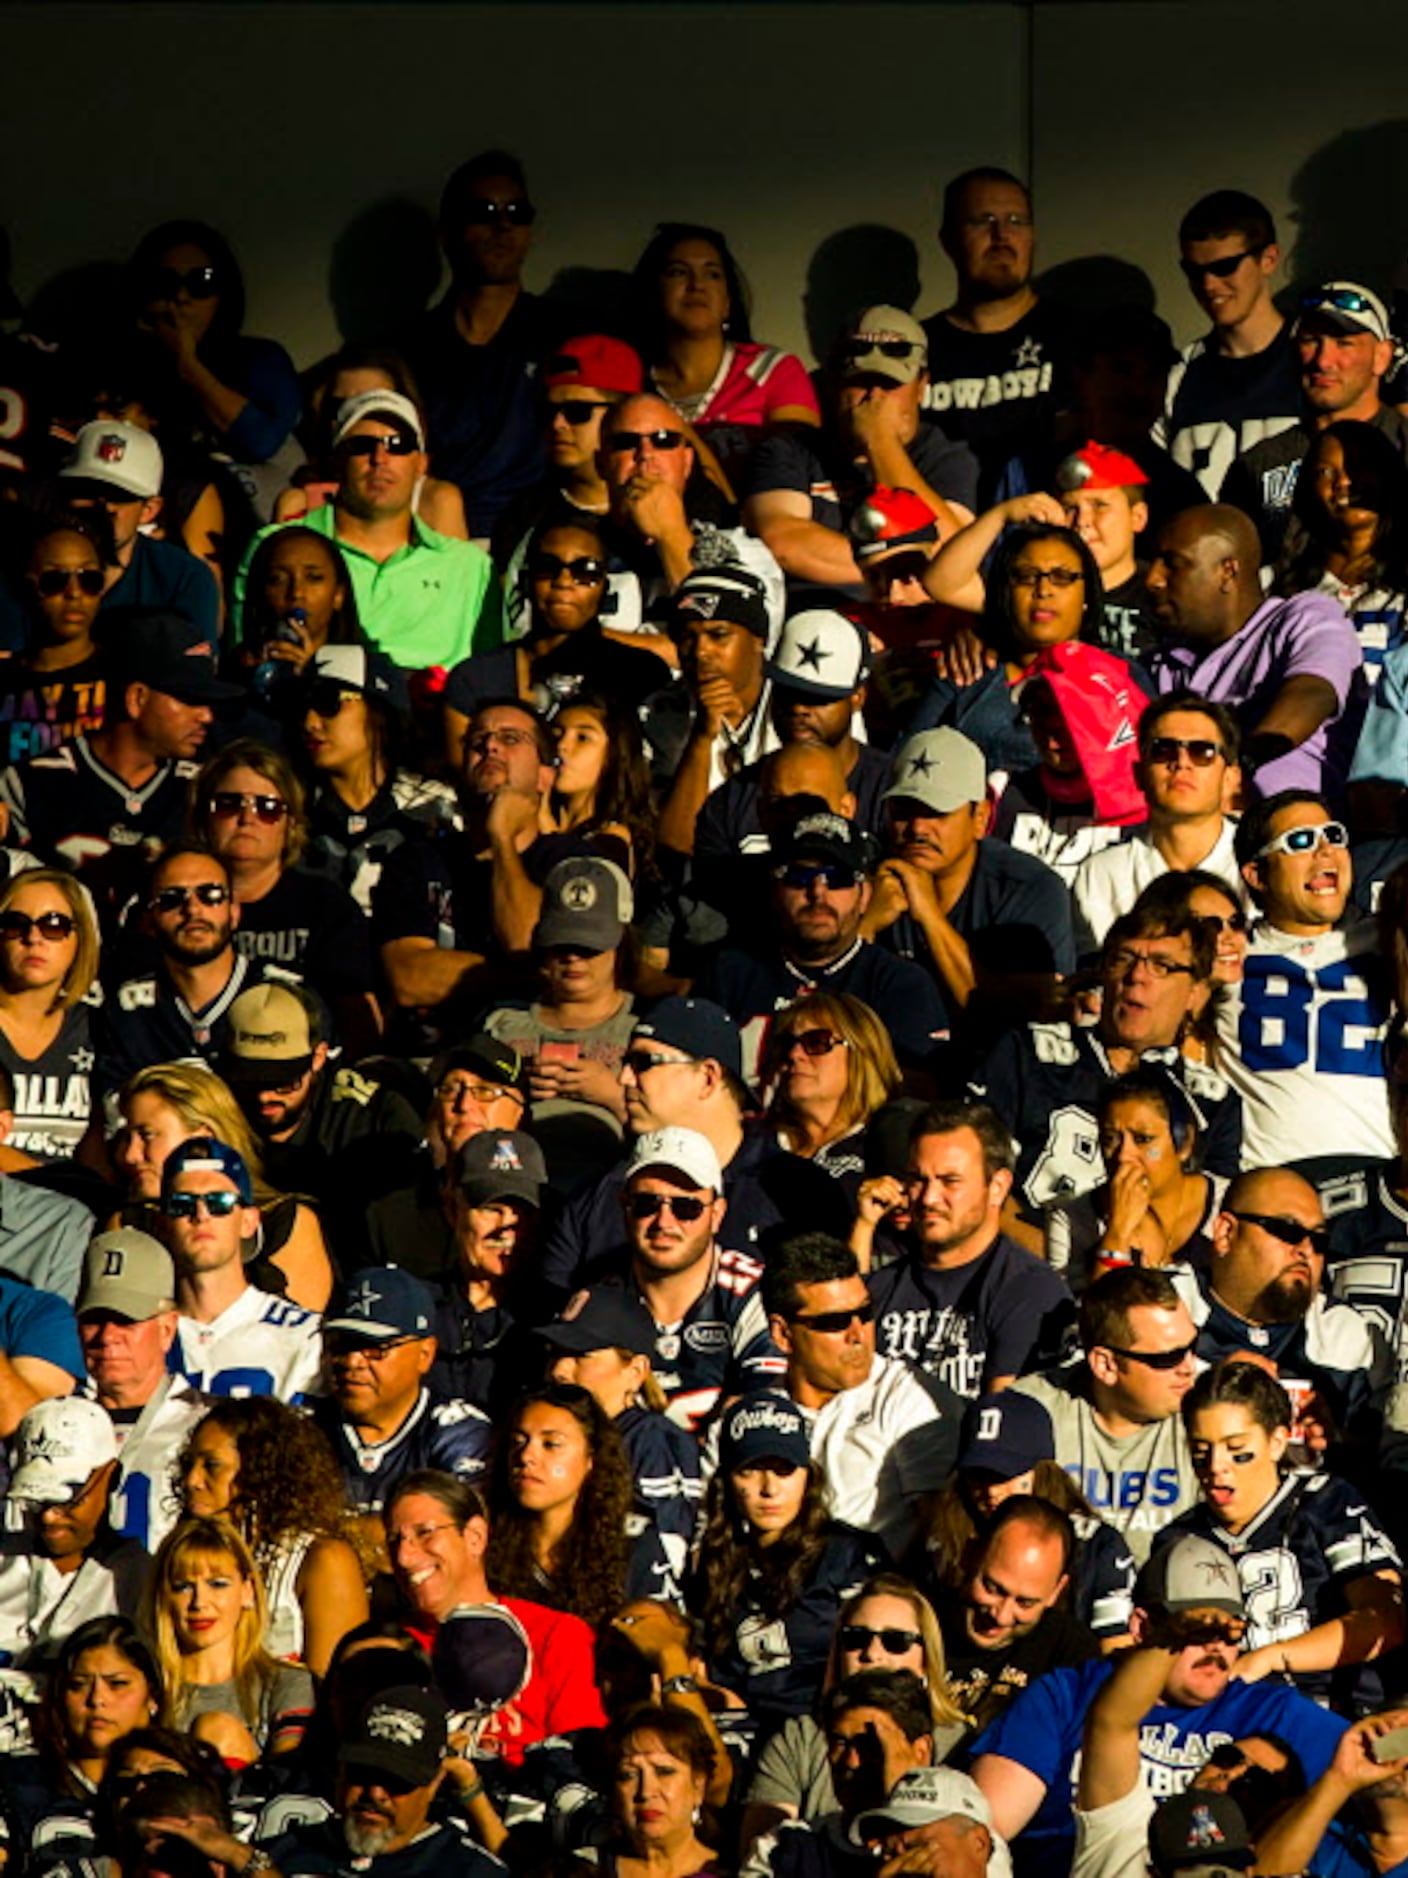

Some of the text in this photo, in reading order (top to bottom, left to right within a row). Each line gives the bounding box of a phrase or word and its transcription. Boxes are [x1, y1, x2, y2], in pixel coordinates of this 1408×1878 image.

[1238, 955, 1391, 1077] 82
[103, 1250, 124, 1277] D
[976, 1407, 1003, 1441] D
[1140, 1722, 1236, 1769] LLAS
